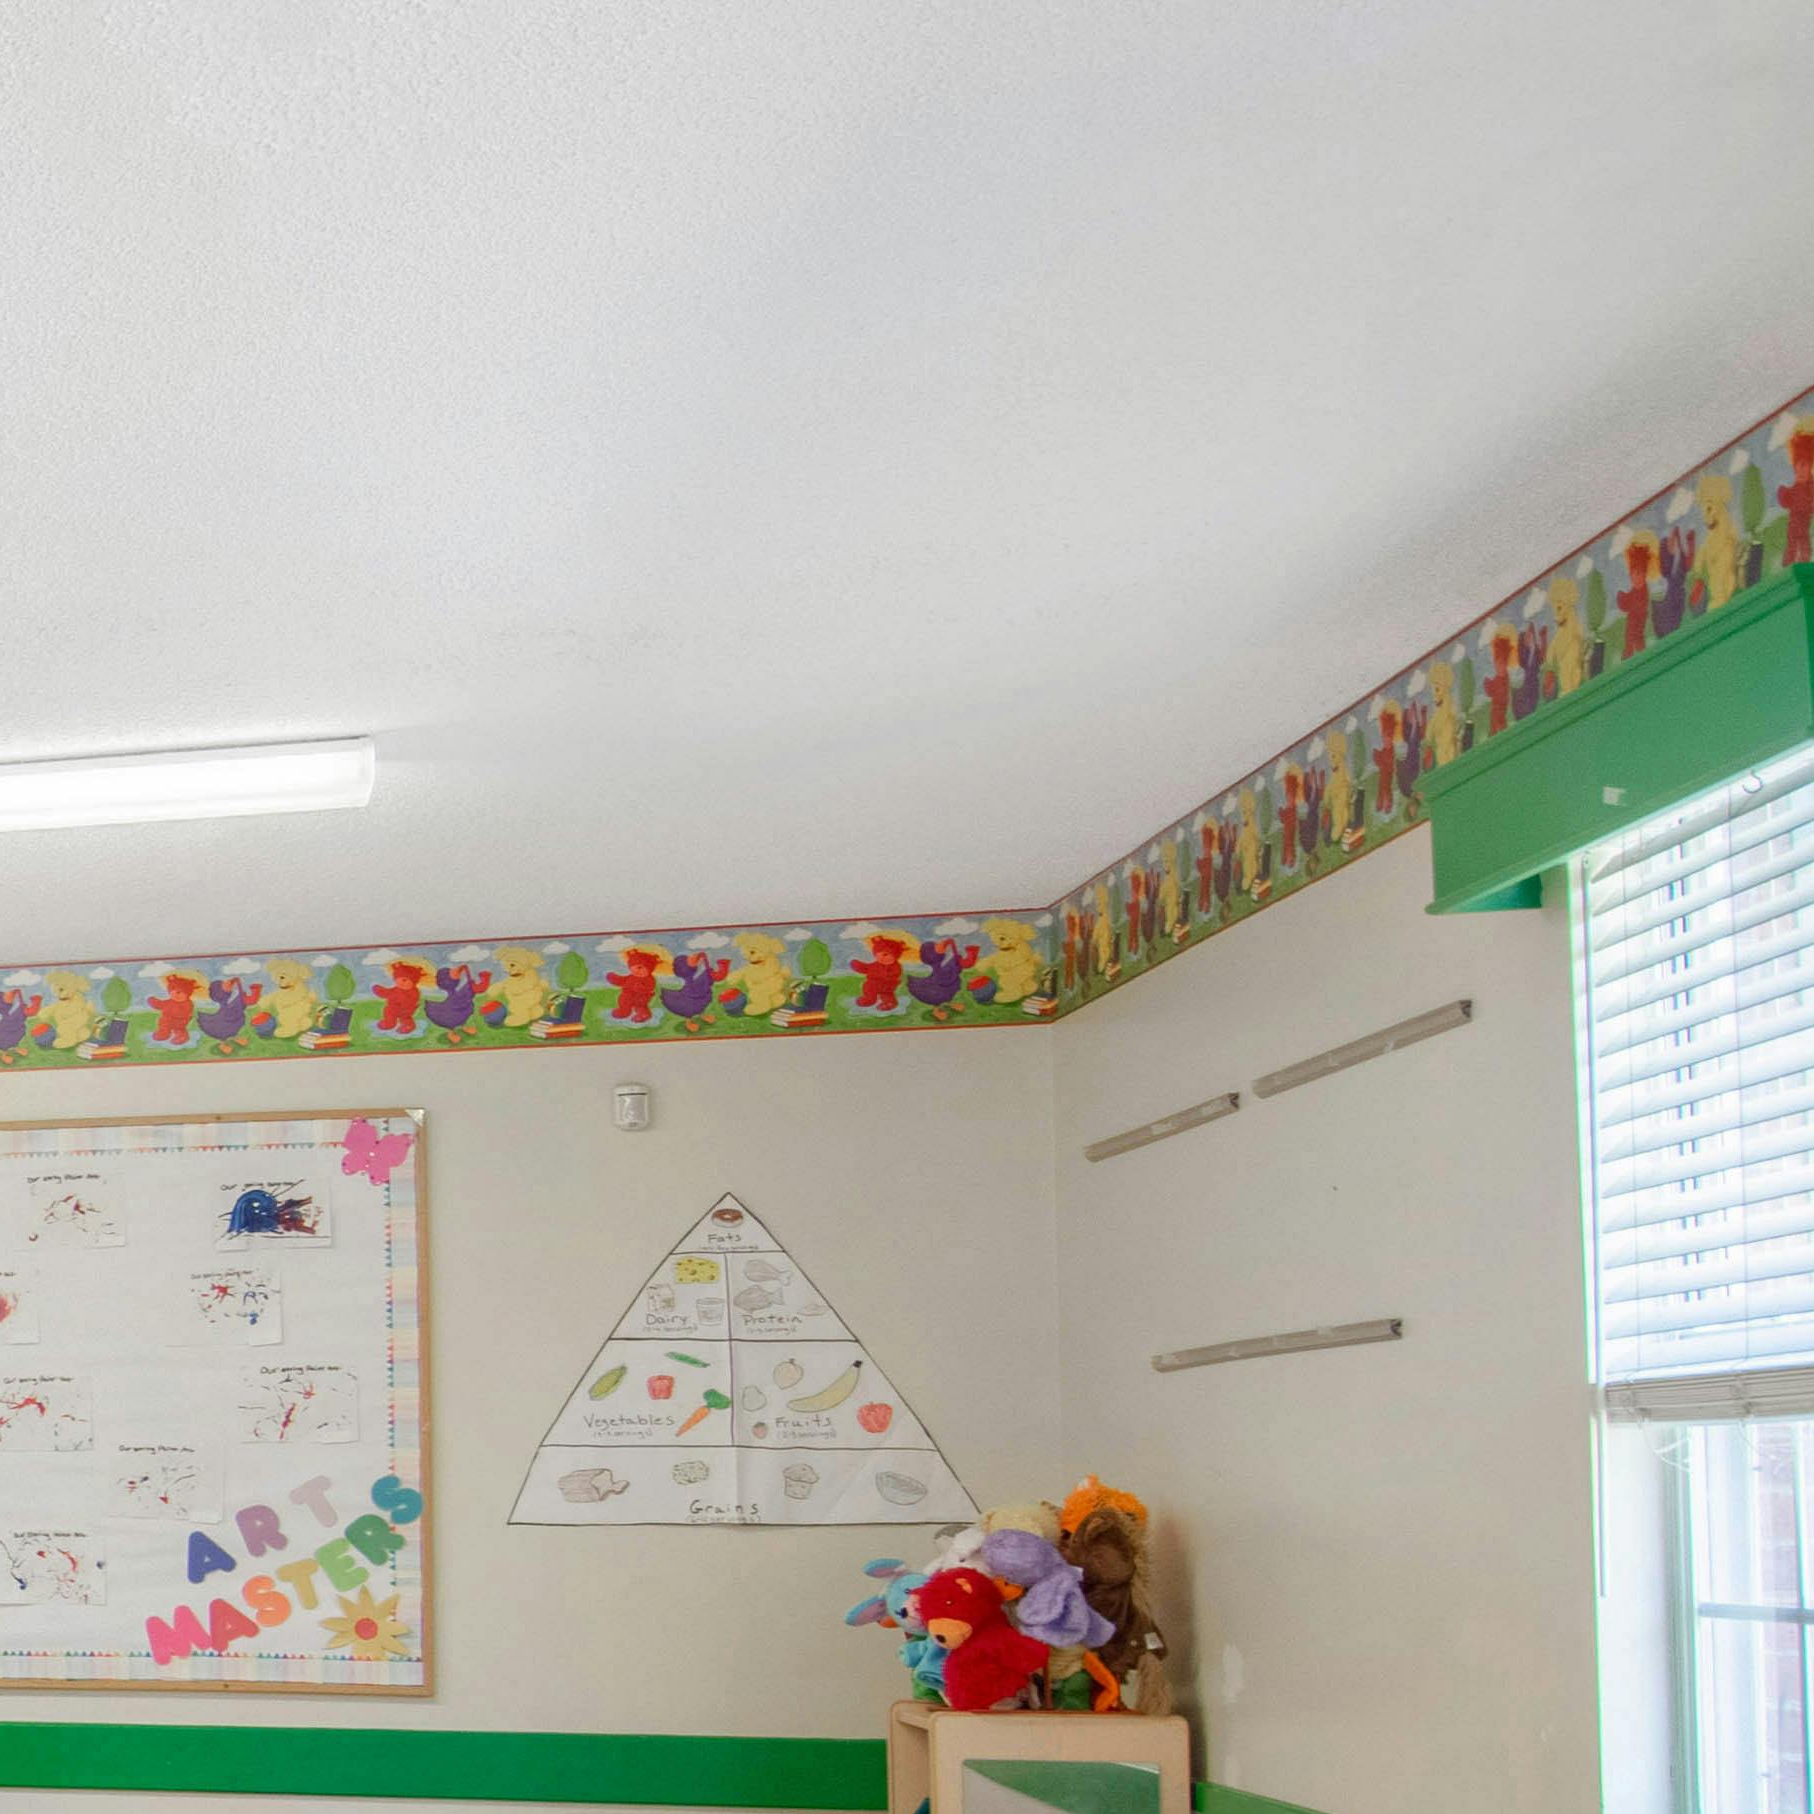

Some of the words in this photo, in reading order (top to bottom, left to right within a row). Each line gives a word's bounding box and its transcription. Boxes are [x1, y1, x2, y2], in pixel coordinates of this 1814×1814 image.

[707, 1233, 742, 1244] Fats
[645, 1313, 688, 1326] Dairy
[742, 1314, 804, 1326] Protein
[583, 1414, 675, 1430] Vegetables
[775, 1416, 833, 1429] Fruits
[689, 1500, 759, 1515] Grains
[187, 1475, 338, 1584] ART
[145, 1475, 424, 1665] MASTERS
